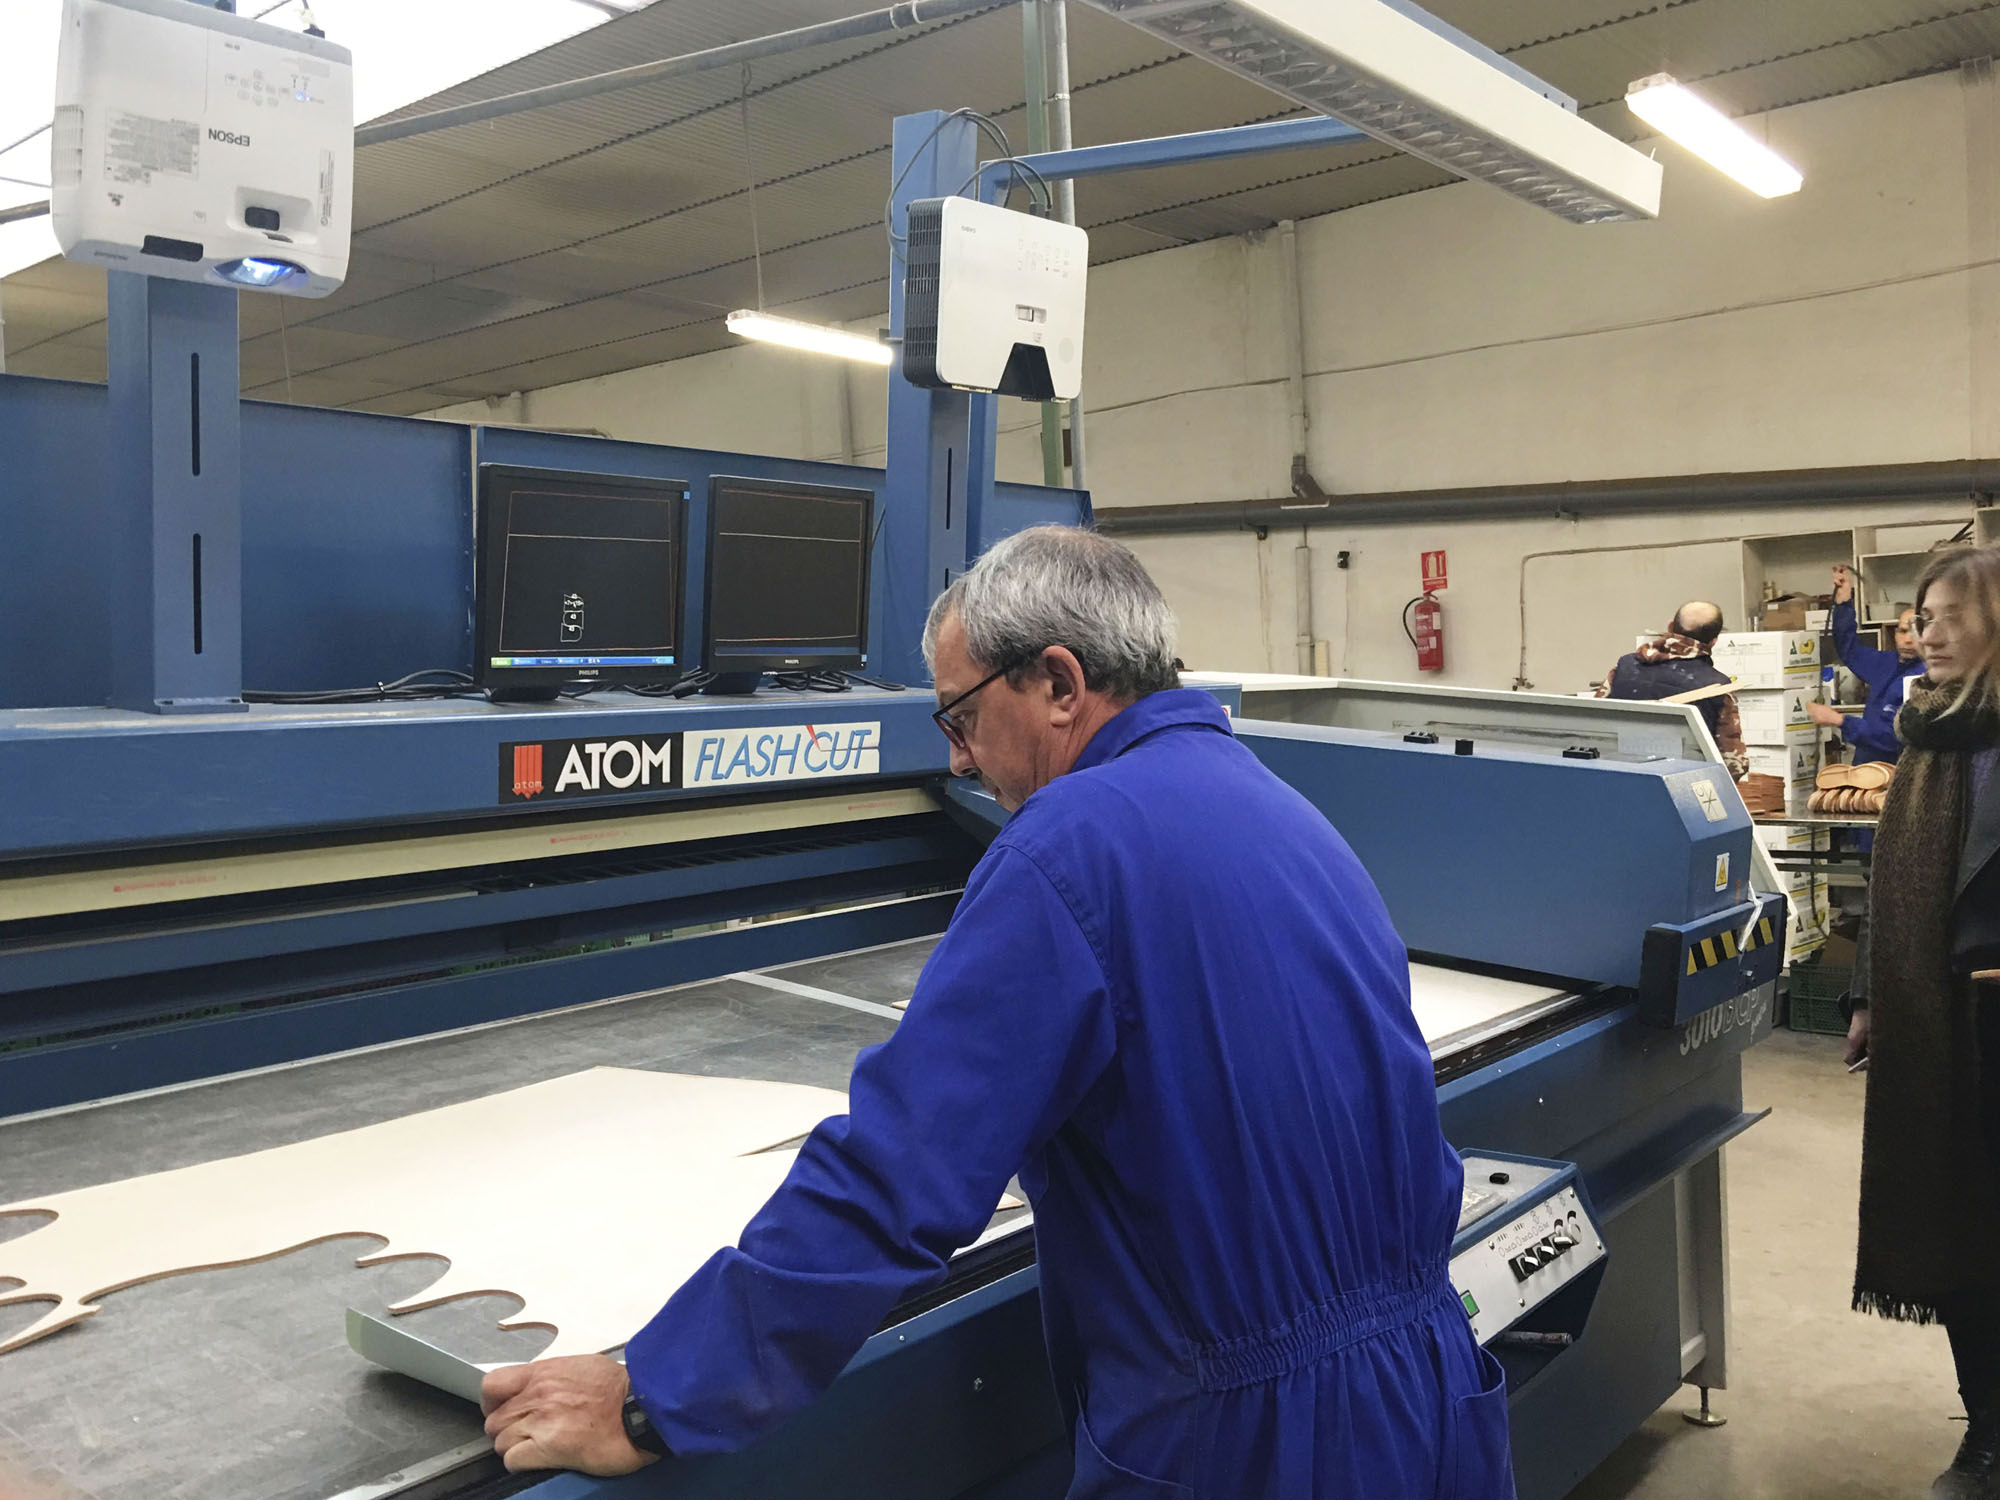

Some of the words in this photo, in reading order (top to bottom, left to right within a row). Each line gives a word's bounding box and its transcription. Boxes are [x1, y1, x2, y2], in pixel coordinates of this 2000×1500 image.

[208, 128, 250, 147] EPSON
[554, 738, 671, 792] ATOM
[694, 733, 801, 782] FLASH
[804, 729, 872, 773] CUT
